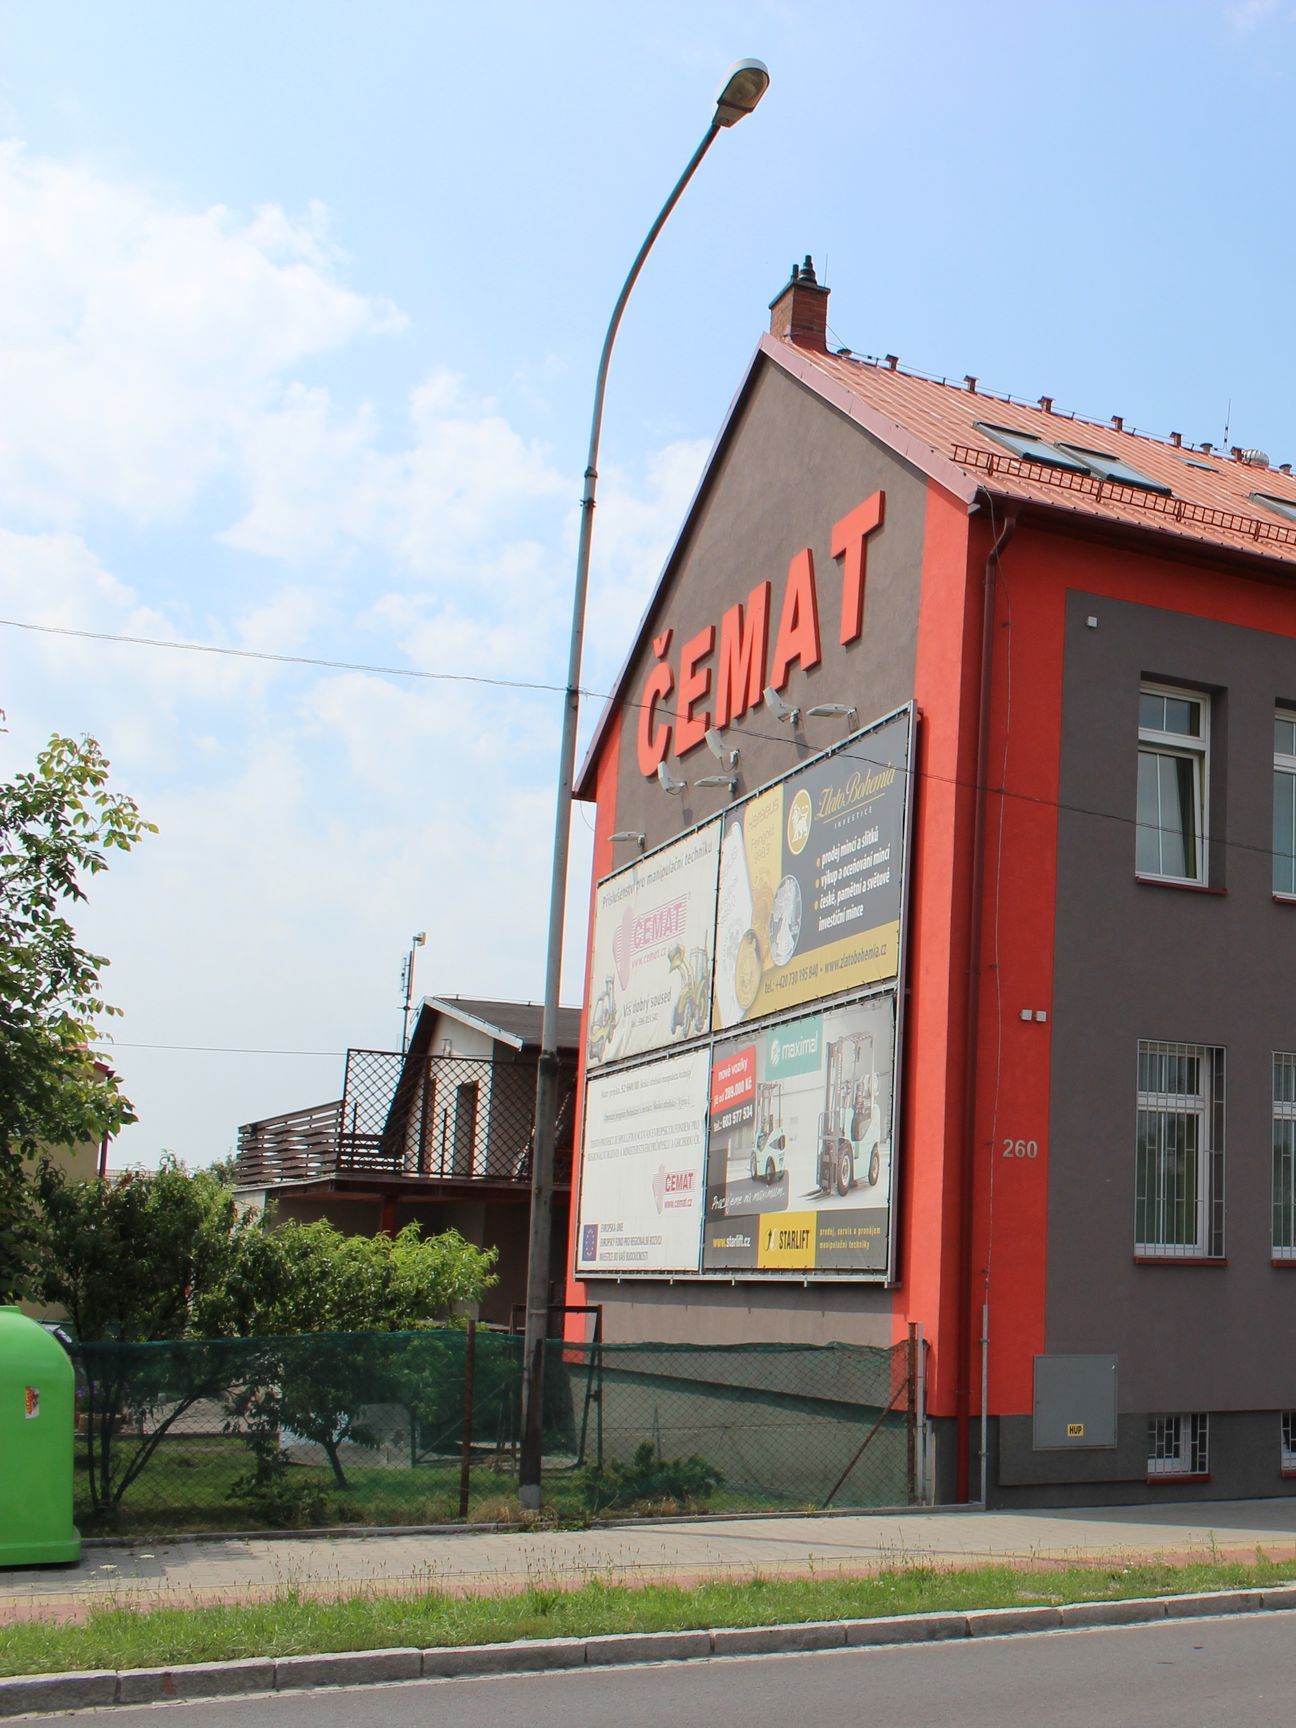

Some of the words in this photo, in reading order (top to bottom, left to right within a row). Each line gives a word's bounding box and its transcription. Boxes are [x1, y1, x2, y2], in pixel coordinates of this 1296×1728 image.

[637, 489, 886, 778] ČEMAT
[846, 762, 897, 802] Bohemia
[834, 806, 873, 830] INVESTICE
[822, 845, 840, 868] prodej
[841, 840, 856, 858] mincí
[635, 876, 646, 897] pro
[646, 857, 684, 887] manipulační
[685, 841, 713, 867] techniku
[821, 869, 838, 890] výkup
[843, 853, 873, 879] oceňování
[873, 843, 890, 864] mincí
[837, 881, 861, 904] pamětní
[867, 867, 890, 892] světové
[818, 908, 845, 931] investiční
[845, 904, 864, 923] mince
[775, 976, 788, 990] +420
[788, 972, 798, 985] 730
[800, 969, 808, 981] 195
[824, 943, 887, 974] www.zlatobohemia.cz
[649, 989, 671, 1009] soused
[782, 1030, 818, 1060] maximal
[718, 1064, 731, 1081] nové
[731, 1057, 748, 1075] vozíky
[745, 1076, 752, 1091] Kč
[733, 1109, 742, 1124] 577
[743, 1105, 753, 1120] 534
[1002, 1139, 1038, 1158] 260
[712, 1234, 751, 1248] www.starlift.cz
[779, 1230, 810, 1250] STARLIFT
[836, 1227, 852, 1236] servis
[857, 1225, 881, 1236] pronájem
[819, 1241, 847, 1251] manipulační
[848, 1240, 870, 1251] techniky
[1069, 1425, 1083, 1435] HUP
